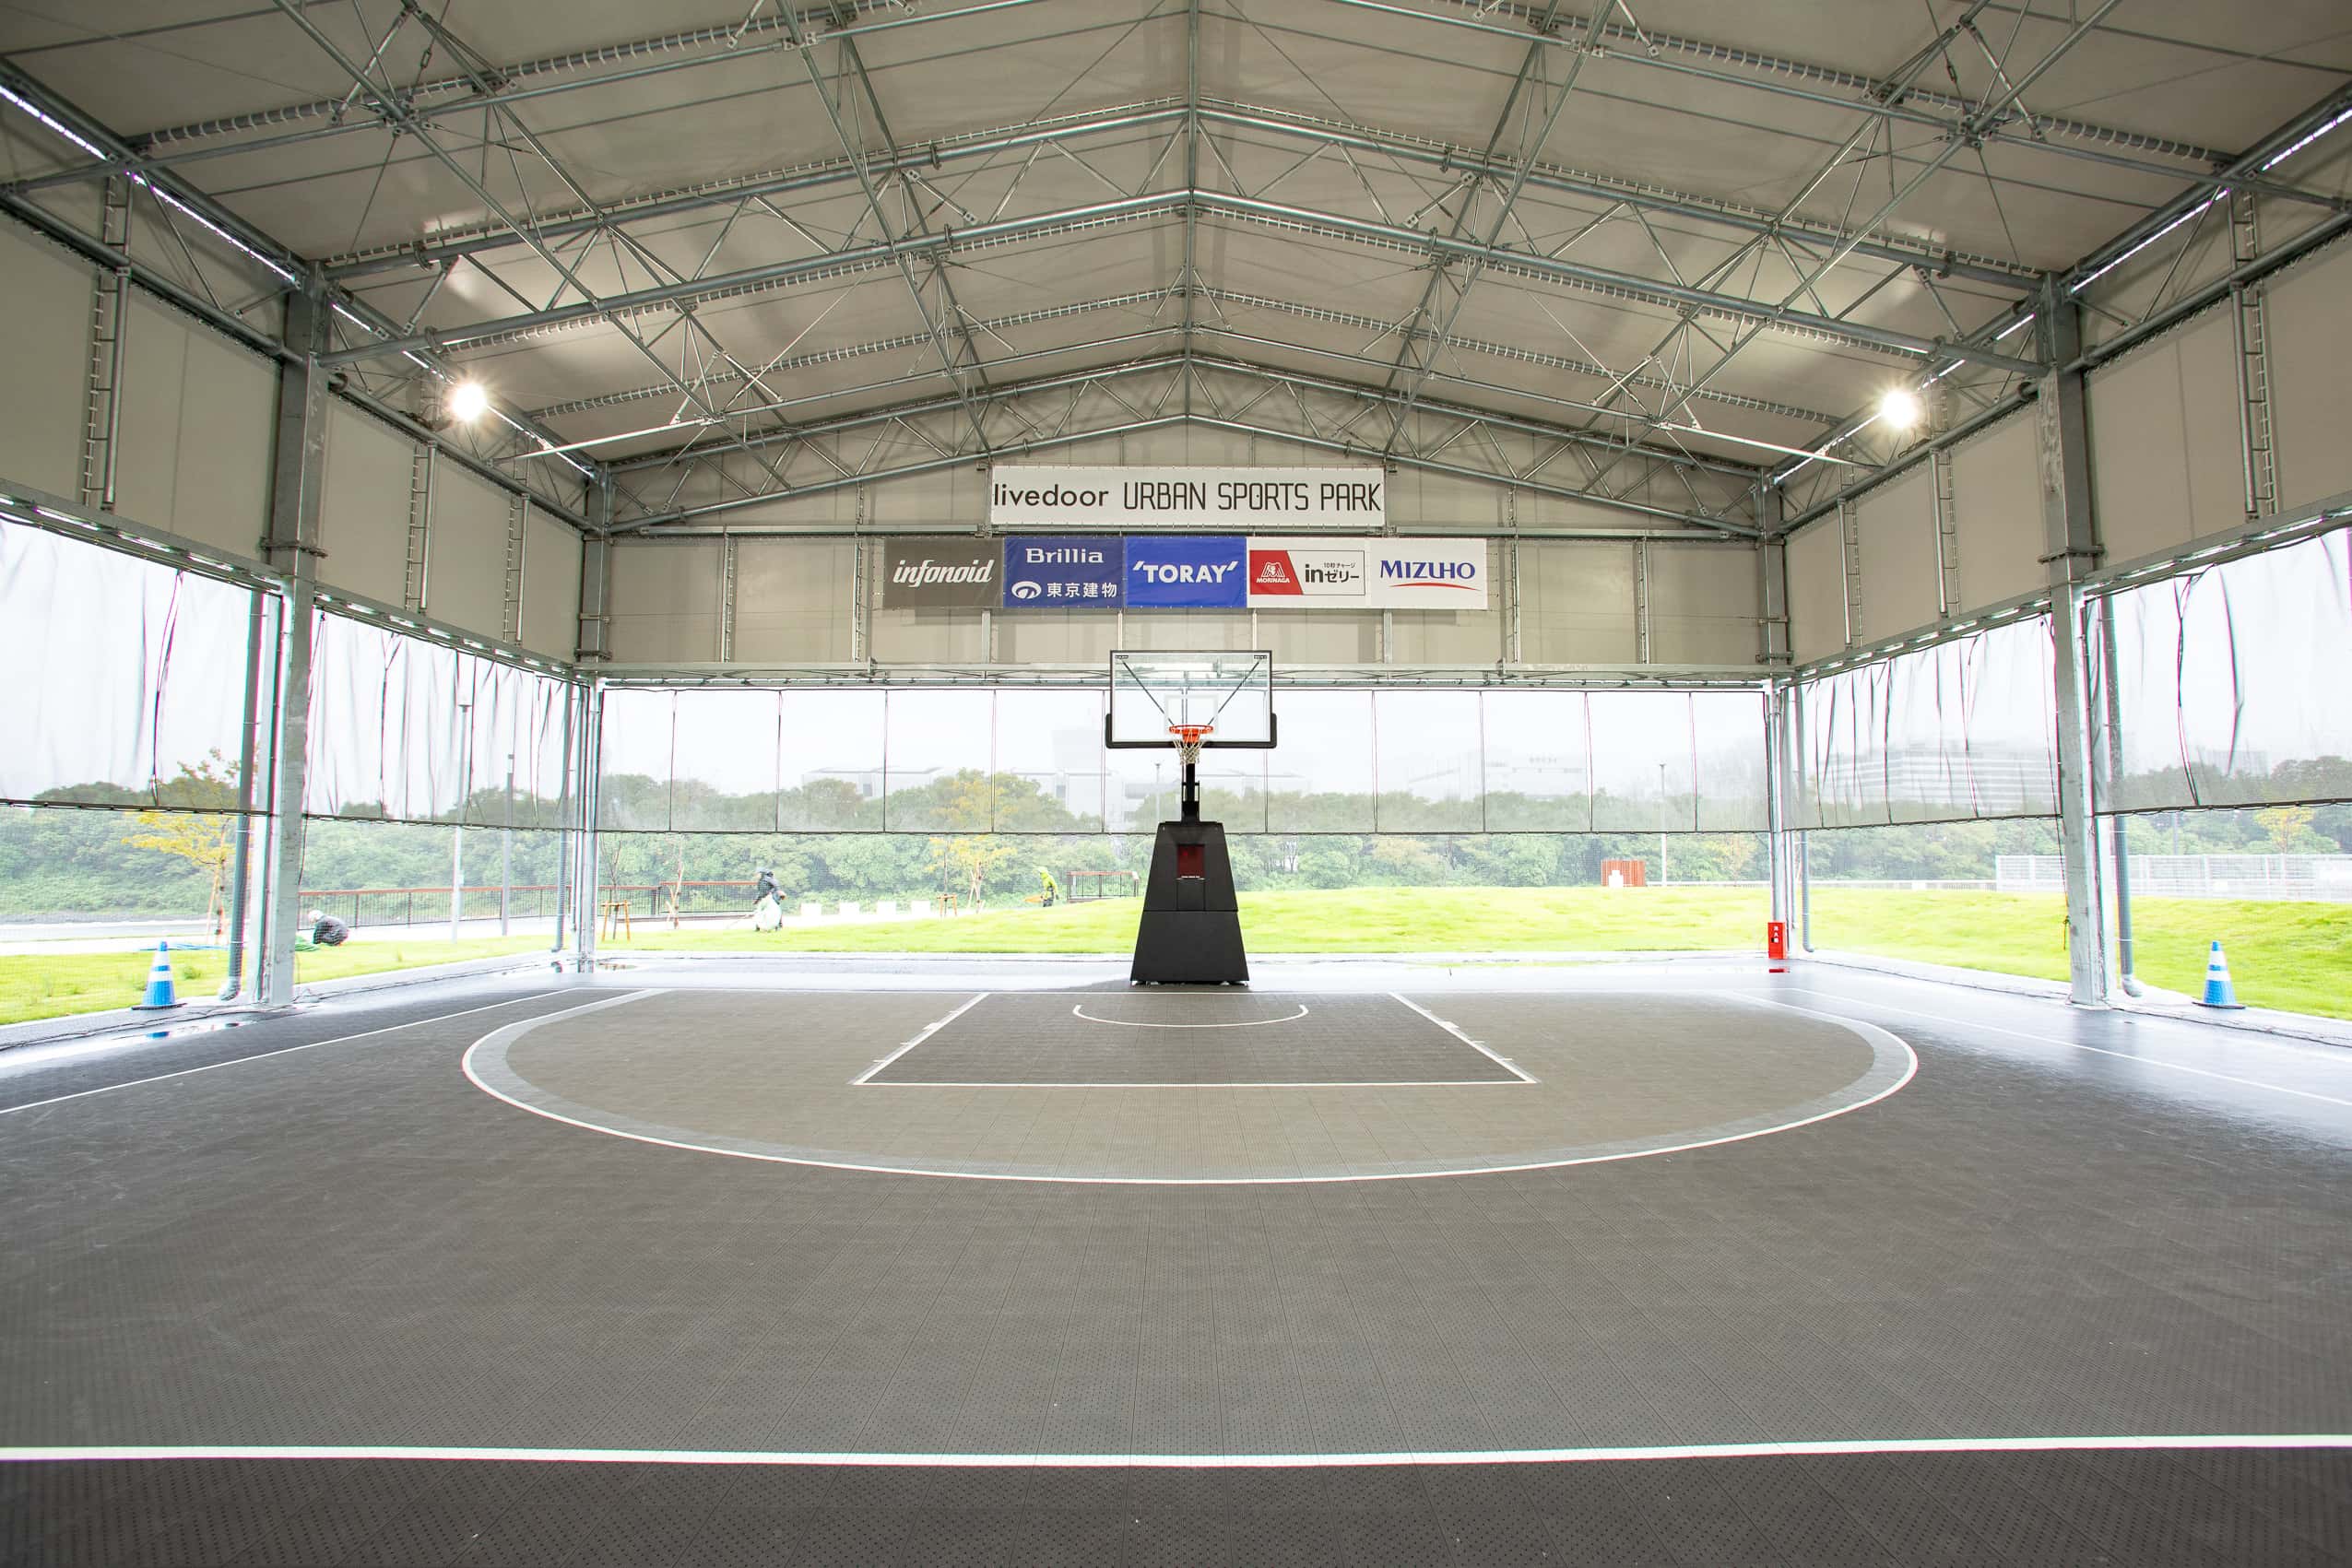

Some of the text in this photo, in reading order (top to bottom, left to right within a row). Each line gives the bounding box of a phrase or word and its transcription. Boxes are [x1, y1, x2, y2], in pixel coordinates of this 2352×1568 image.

[994, 482, 1381, 512] livedoor URBAN SPORTS PARK
[1025, 548, 1104, 563] Brillia
[892, 559, 996, 588] infonoid
[1380, 560, 1476, 579] MIZUHO
[1046, 582, 1117, 598] 東京建物
